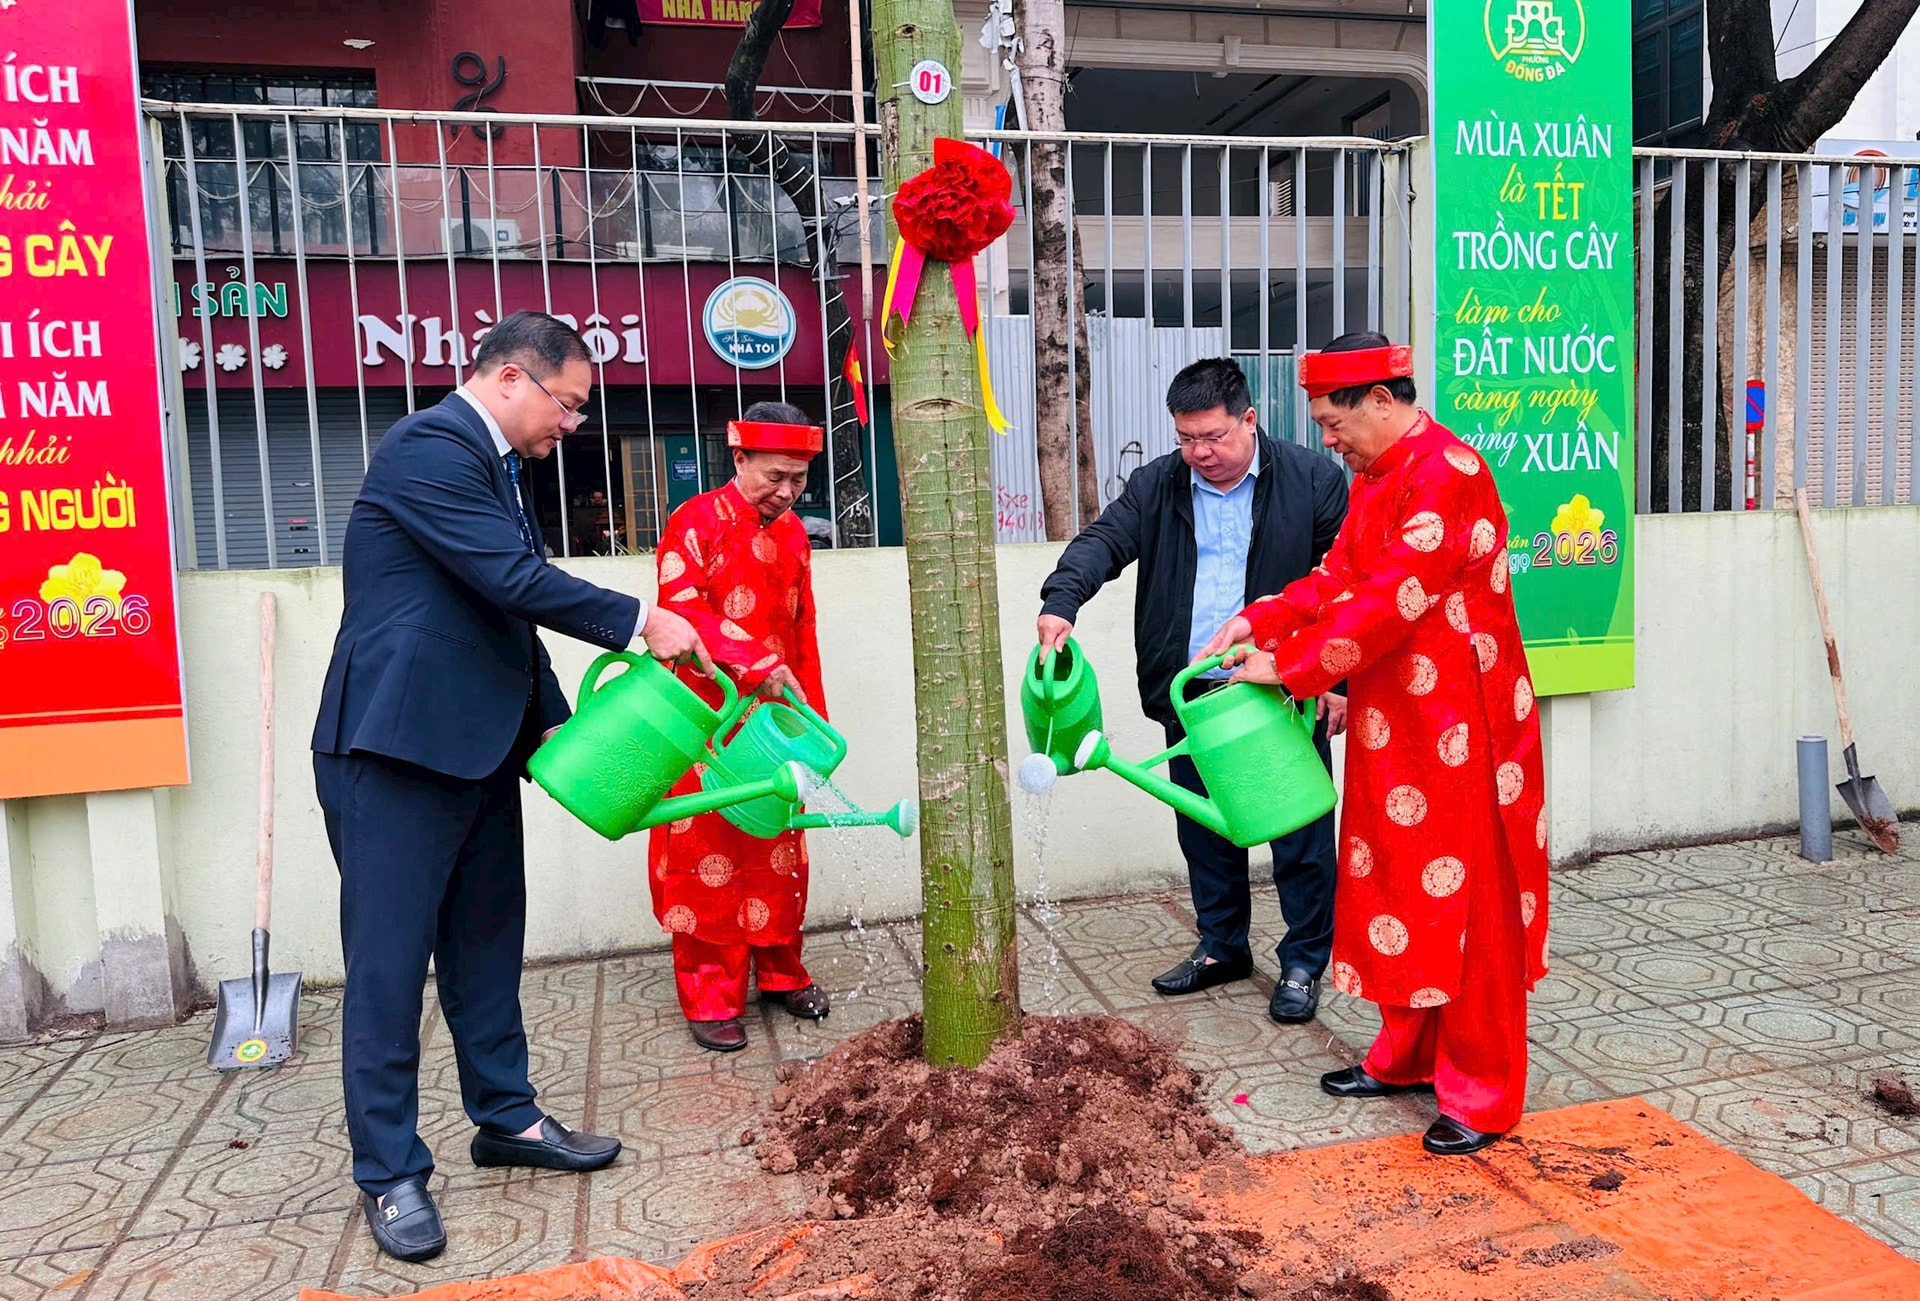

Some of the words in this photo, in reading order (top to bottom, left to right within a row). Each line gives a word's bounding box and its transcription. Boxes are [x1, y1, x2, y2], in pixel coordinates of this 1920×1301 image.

[4, 51, 81, 103] ÍCH
[919, 70, 942, 94] 01
[1544, 61, 1566, 80] ĐA
[0, 117, 95, 166] NĂM
[1455, 109, 1527, 157] MÙA
[1532, 113, 1612, 158] XUÂN
[0, 173, 52, 210] hải
[1500, 162, 1527, 203] là
[1533, 161, 1585, 220] TẾT
[26, 219, 114, 277] CÂY
[1453, 210, 1557, 270] TRỒNG
[1565, 221, 1619, 270] CÂY
[191, 266, 288, 318] SẢN
[1455, 287, 1511, 324] làm
[1517, 285, 1562, 323] cho
[28, 308, 102, 358] ÍCH
[550, 313, 646, 364] ôi
[1453, 317, 1514, 376] ĐẤT
[1523, 323, 1616, 374] NƯỚC
[18, 371, 112, 418] NĂM
[1454, 381, 1520, 426] càng
[1527, 379, 1599, 425] ngày
[1520, 421, 1619, 472] XUÂN
[21, 471, 136, 531] NGƯỜI
[1509, 553, 1531, 574] gọ
[1532, 529, 1618, 567] 2026
[12, 594, 152, 641] 2026
